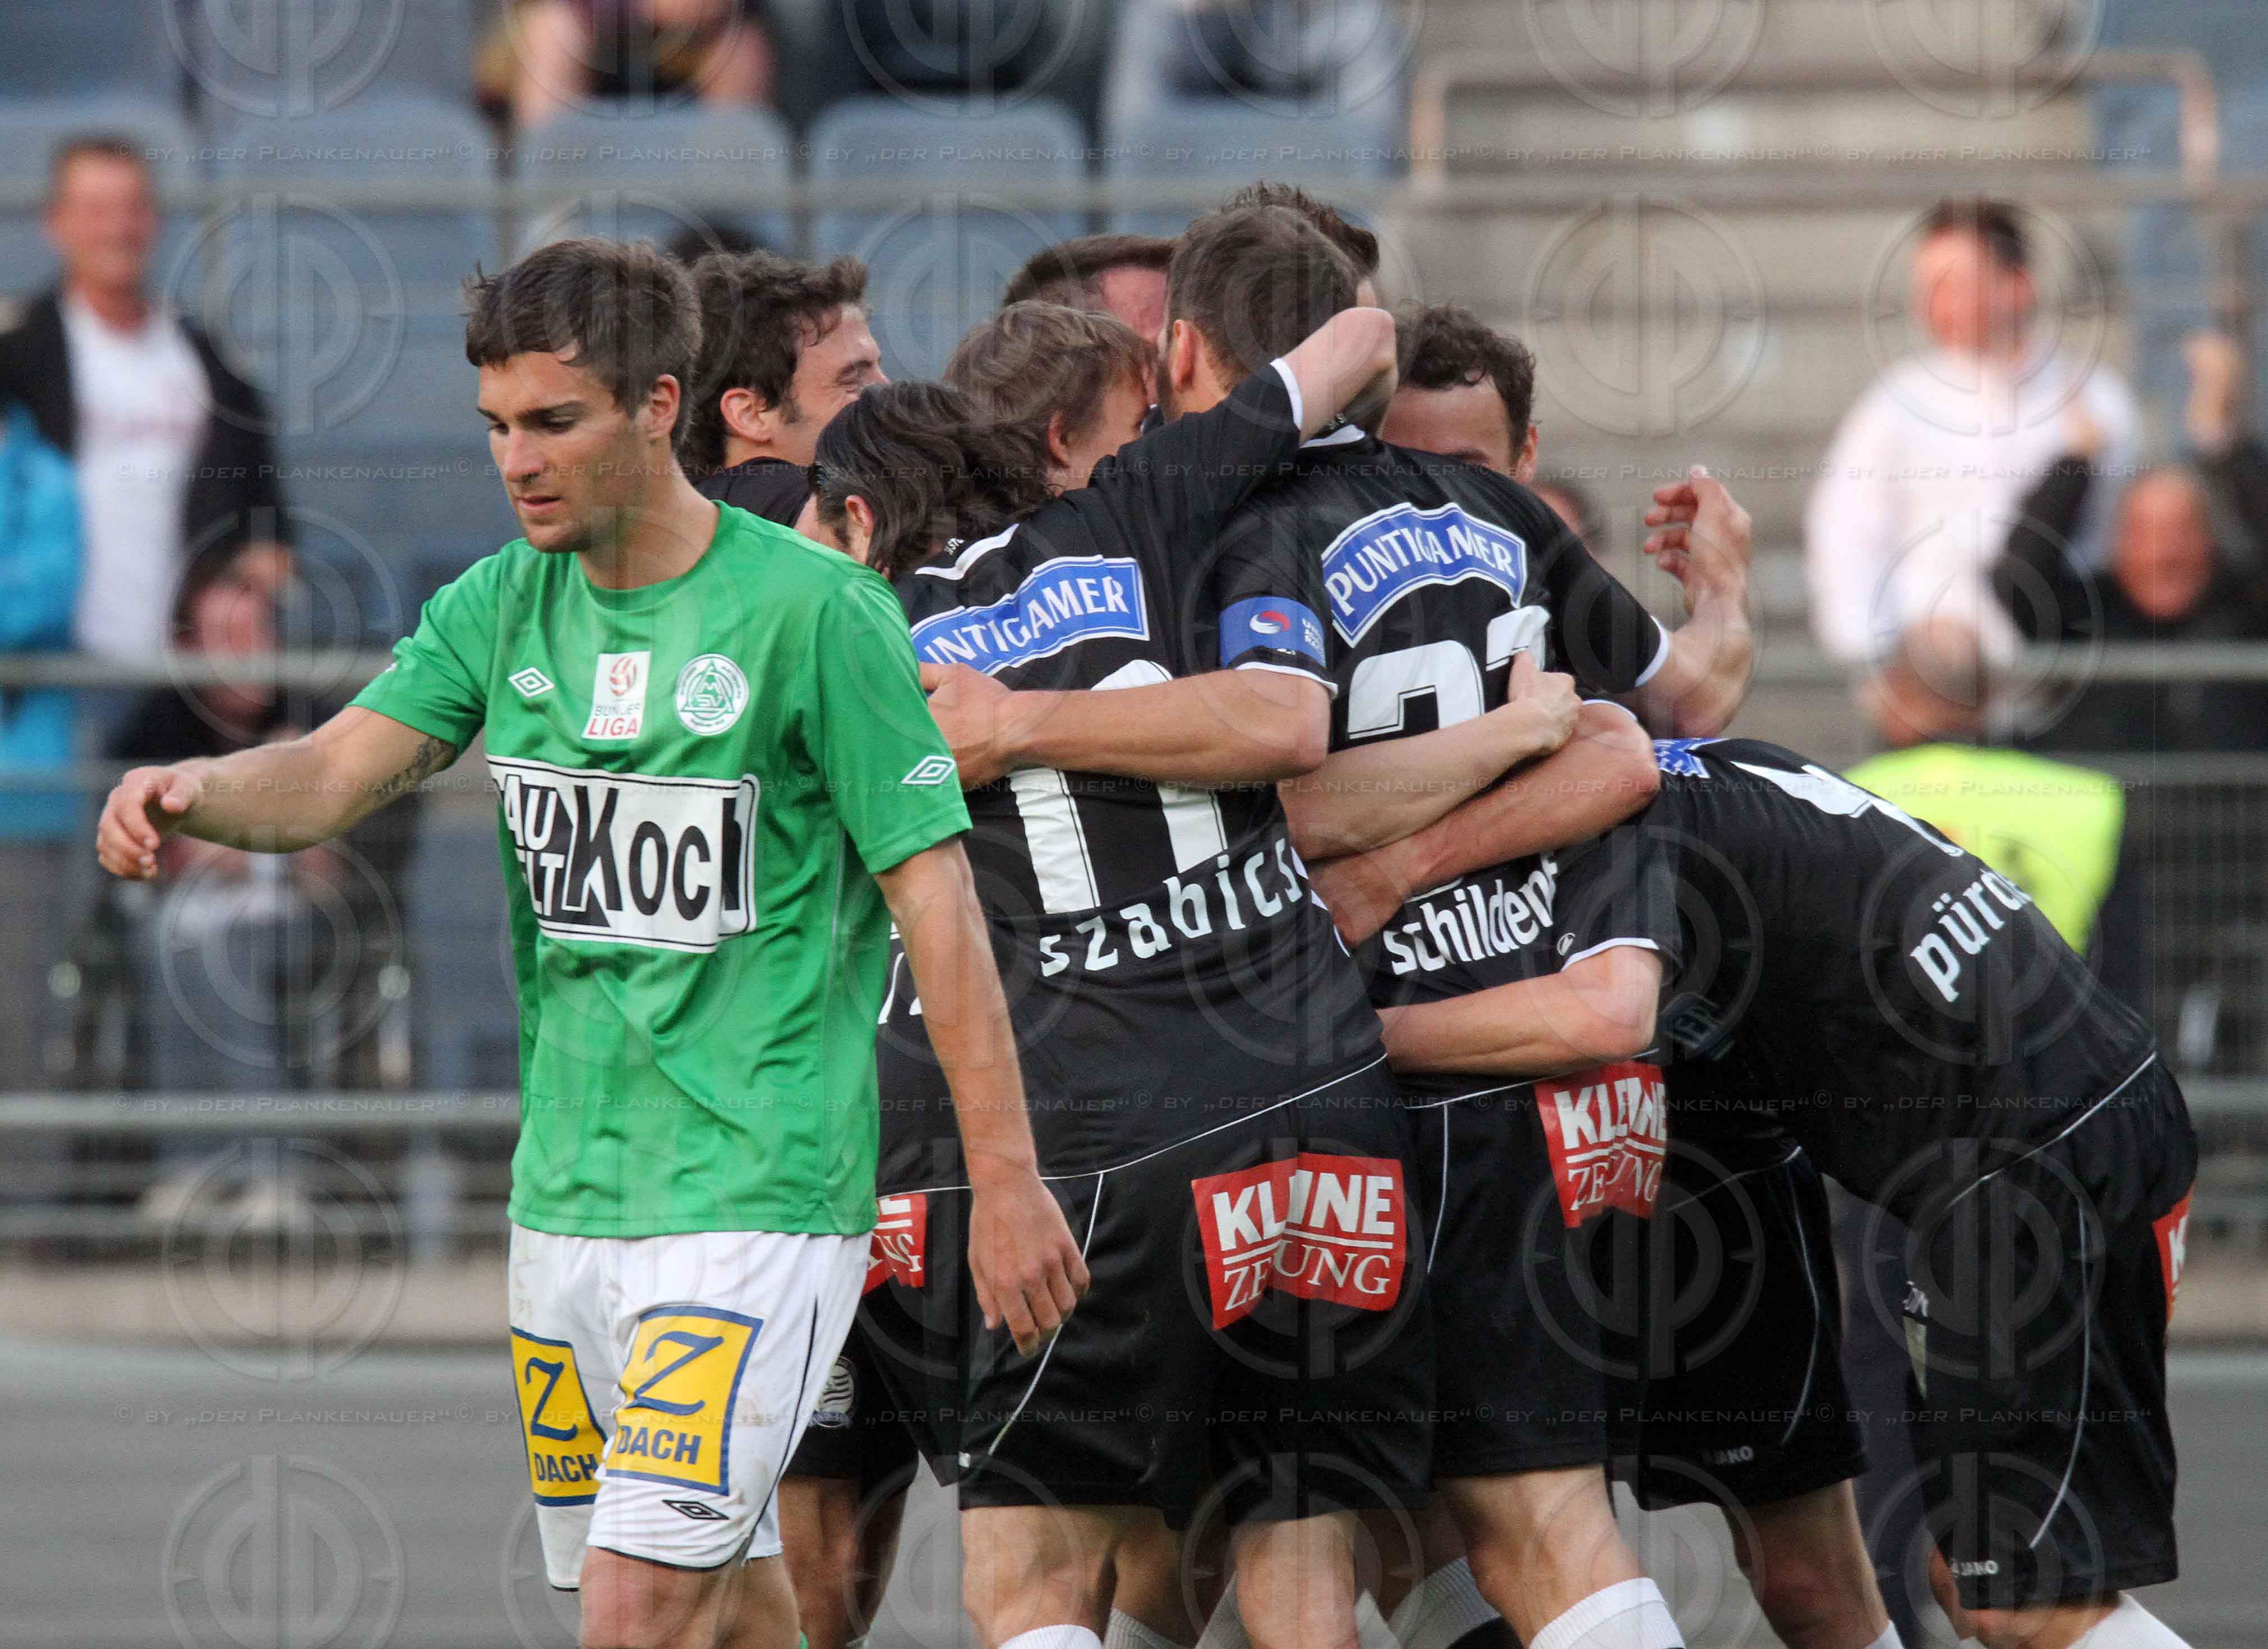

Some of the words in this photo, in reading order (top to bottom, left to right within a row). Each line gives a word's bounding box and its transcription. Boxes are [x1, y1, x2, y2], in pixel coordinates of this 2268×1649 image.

[1325, 524, 1516, 616] PUNTIGAMER
[588, 717, 638, 736] LIGA
[1039, 838, 1302, 977] szabics
[525, 1357, 579, 1441] Z
[625, 1331, 724, 1416] Z
[534, 1453, 599, 1483] DACH
[616, 1425, 702, 1465] DACH
